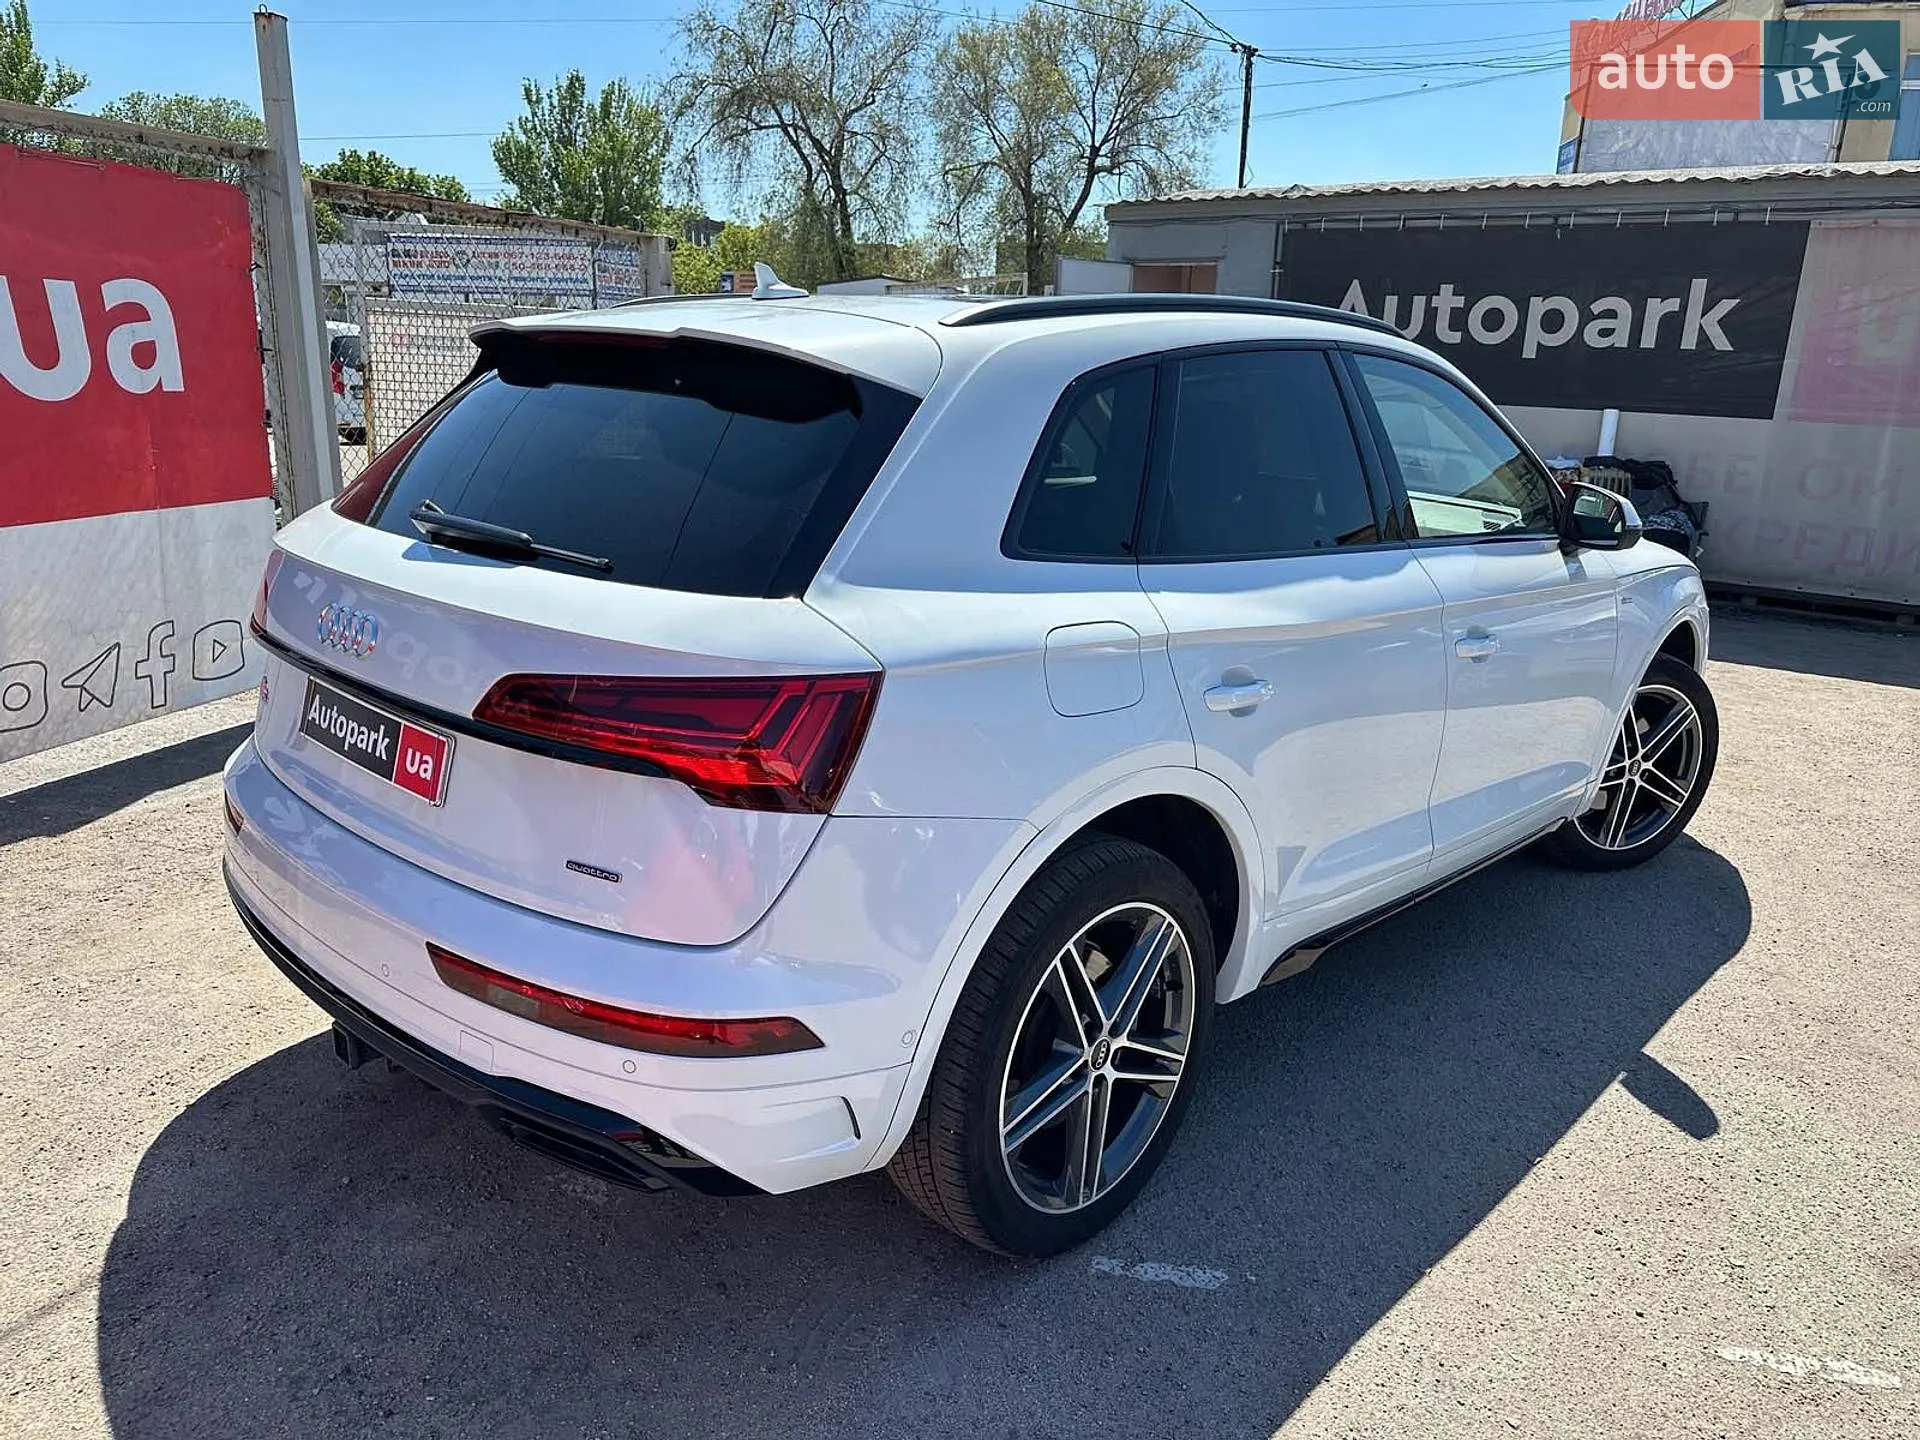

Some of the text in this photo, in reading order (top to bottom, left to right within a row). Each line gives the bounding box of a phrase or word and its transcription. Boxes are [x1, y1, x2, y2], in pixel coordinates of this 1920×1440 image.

[0, 275, 185, 402] ua
[1337, 277, 1741, 359] Autopark
[308, 694, 434, 781] Autopark ua
[566, 862, 618, 881] quattro
